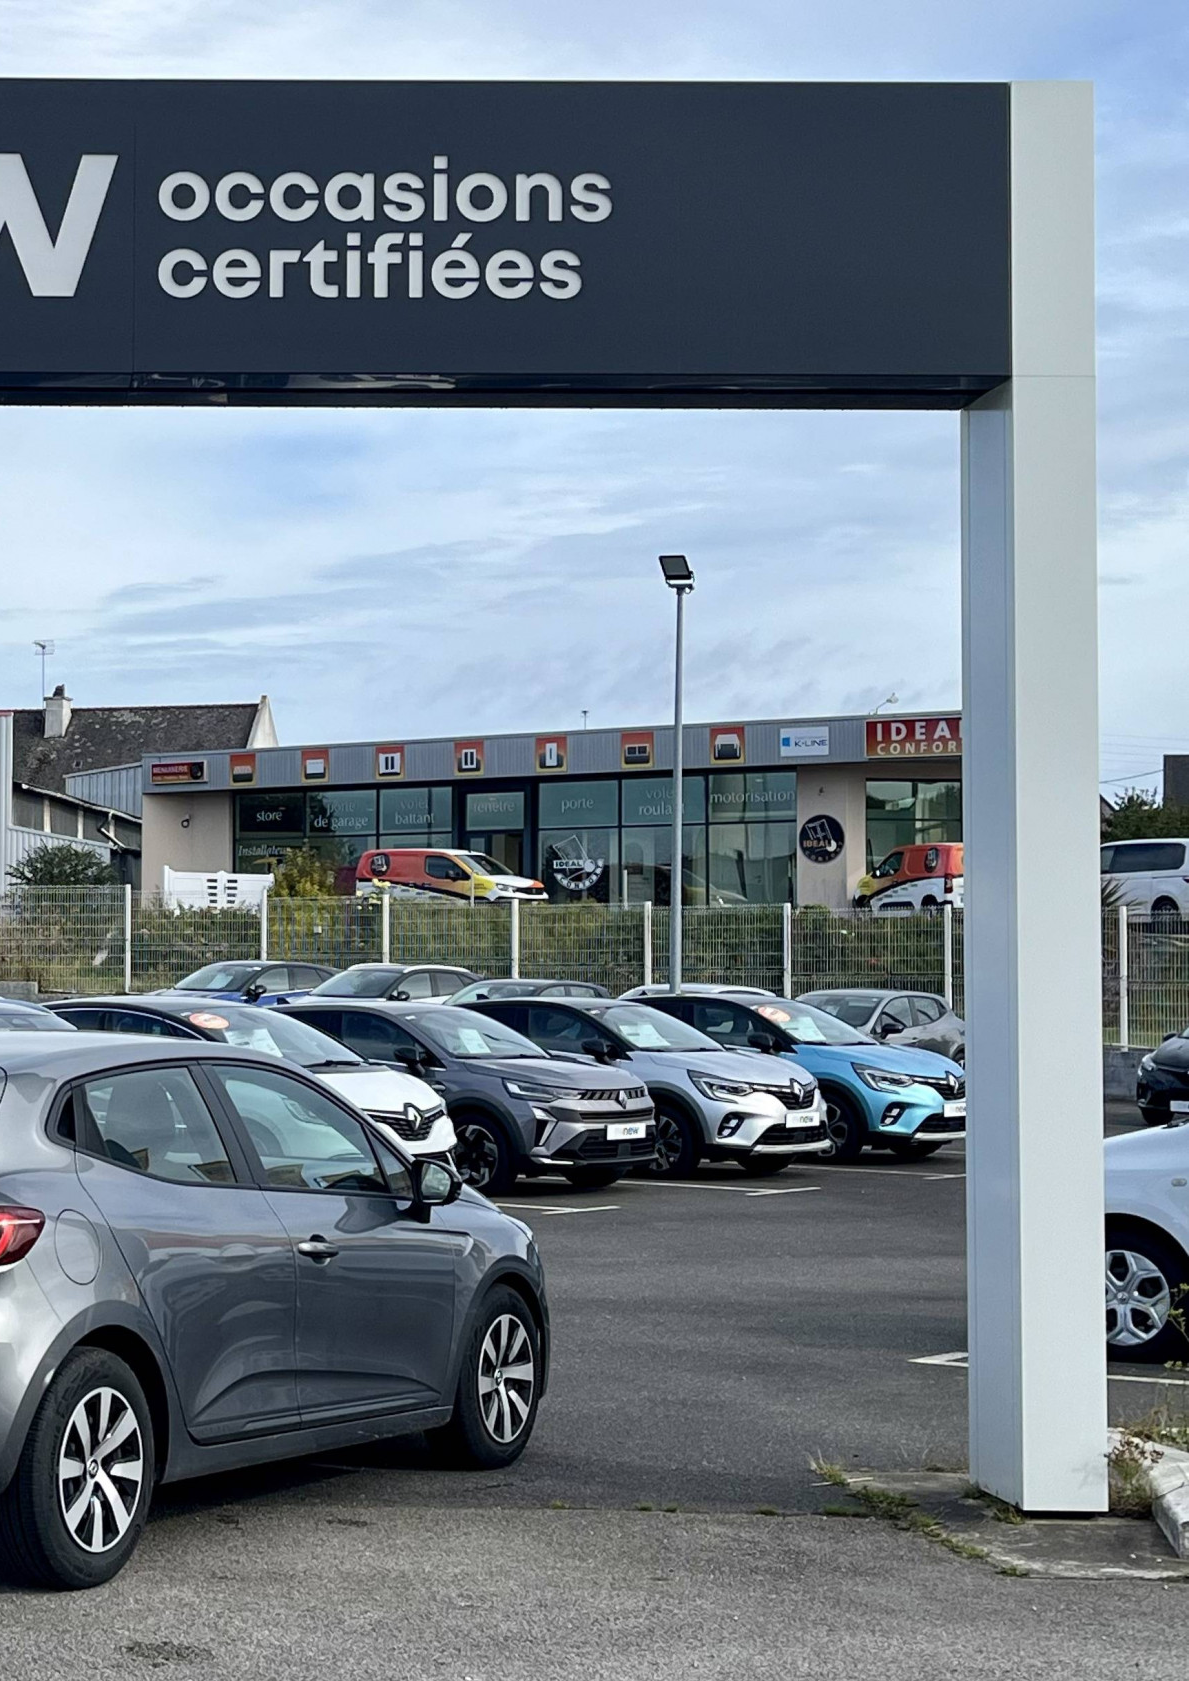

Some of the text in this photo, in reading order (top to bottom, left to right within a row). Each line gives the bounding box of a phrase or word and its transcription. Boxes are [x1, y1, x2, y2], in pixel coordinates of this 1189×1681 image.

[157, 154, 614, 223] occasions
[157, 232, 583, 299] certifiées
[876, 719, 962, 742] IDEA
[877, 740, 958, 755] CONFOR
[646, 784, 675, 800] vole
[709, 788, 796, 804] motorisation
[560, 797, 594, 813] porte
[638, 800, 685, 816] roula
[256, 809, 283, 822] store
[313, 815, 369, 831] de garage
[394, 811, 435, 825] battant
[238, 844, 288, 857] Installateu
